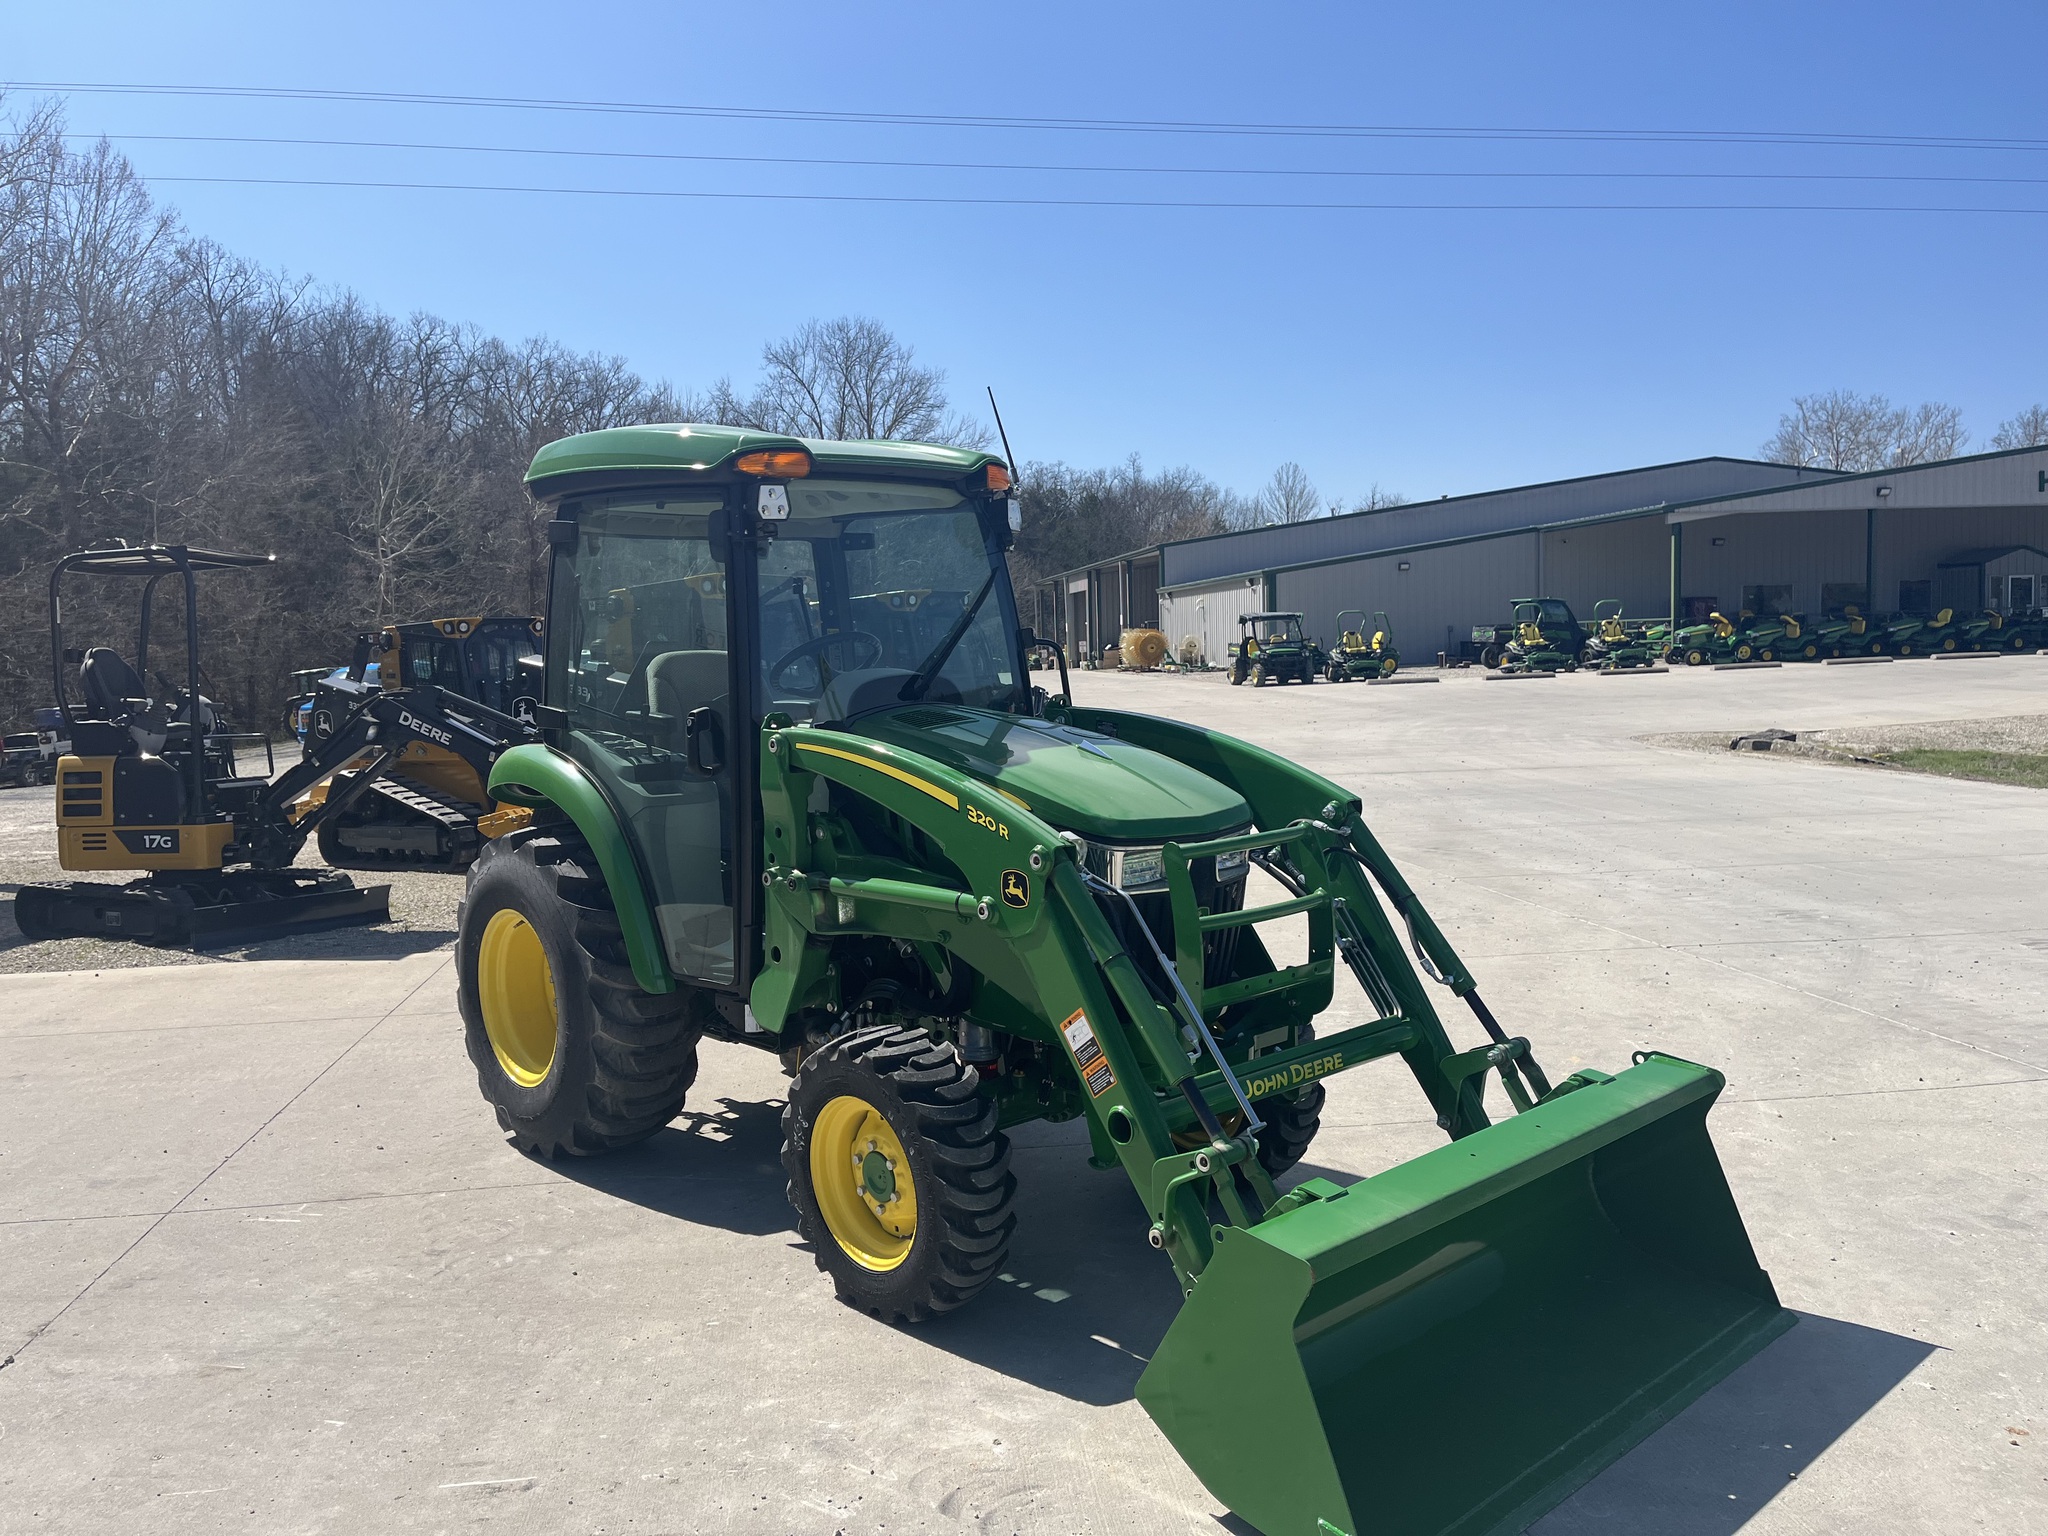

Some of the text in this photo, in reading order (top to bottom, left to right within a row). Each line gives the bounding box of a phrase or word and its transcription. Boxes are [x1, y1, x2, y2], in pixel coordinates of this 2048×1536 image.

[398, 710, 453, 746] DEERE
[966, 804, 1010, 841] 320 R
[143, 834, 172, 849] 17G
[1245, 1052, 1344, 1100] JOHN DEERE
